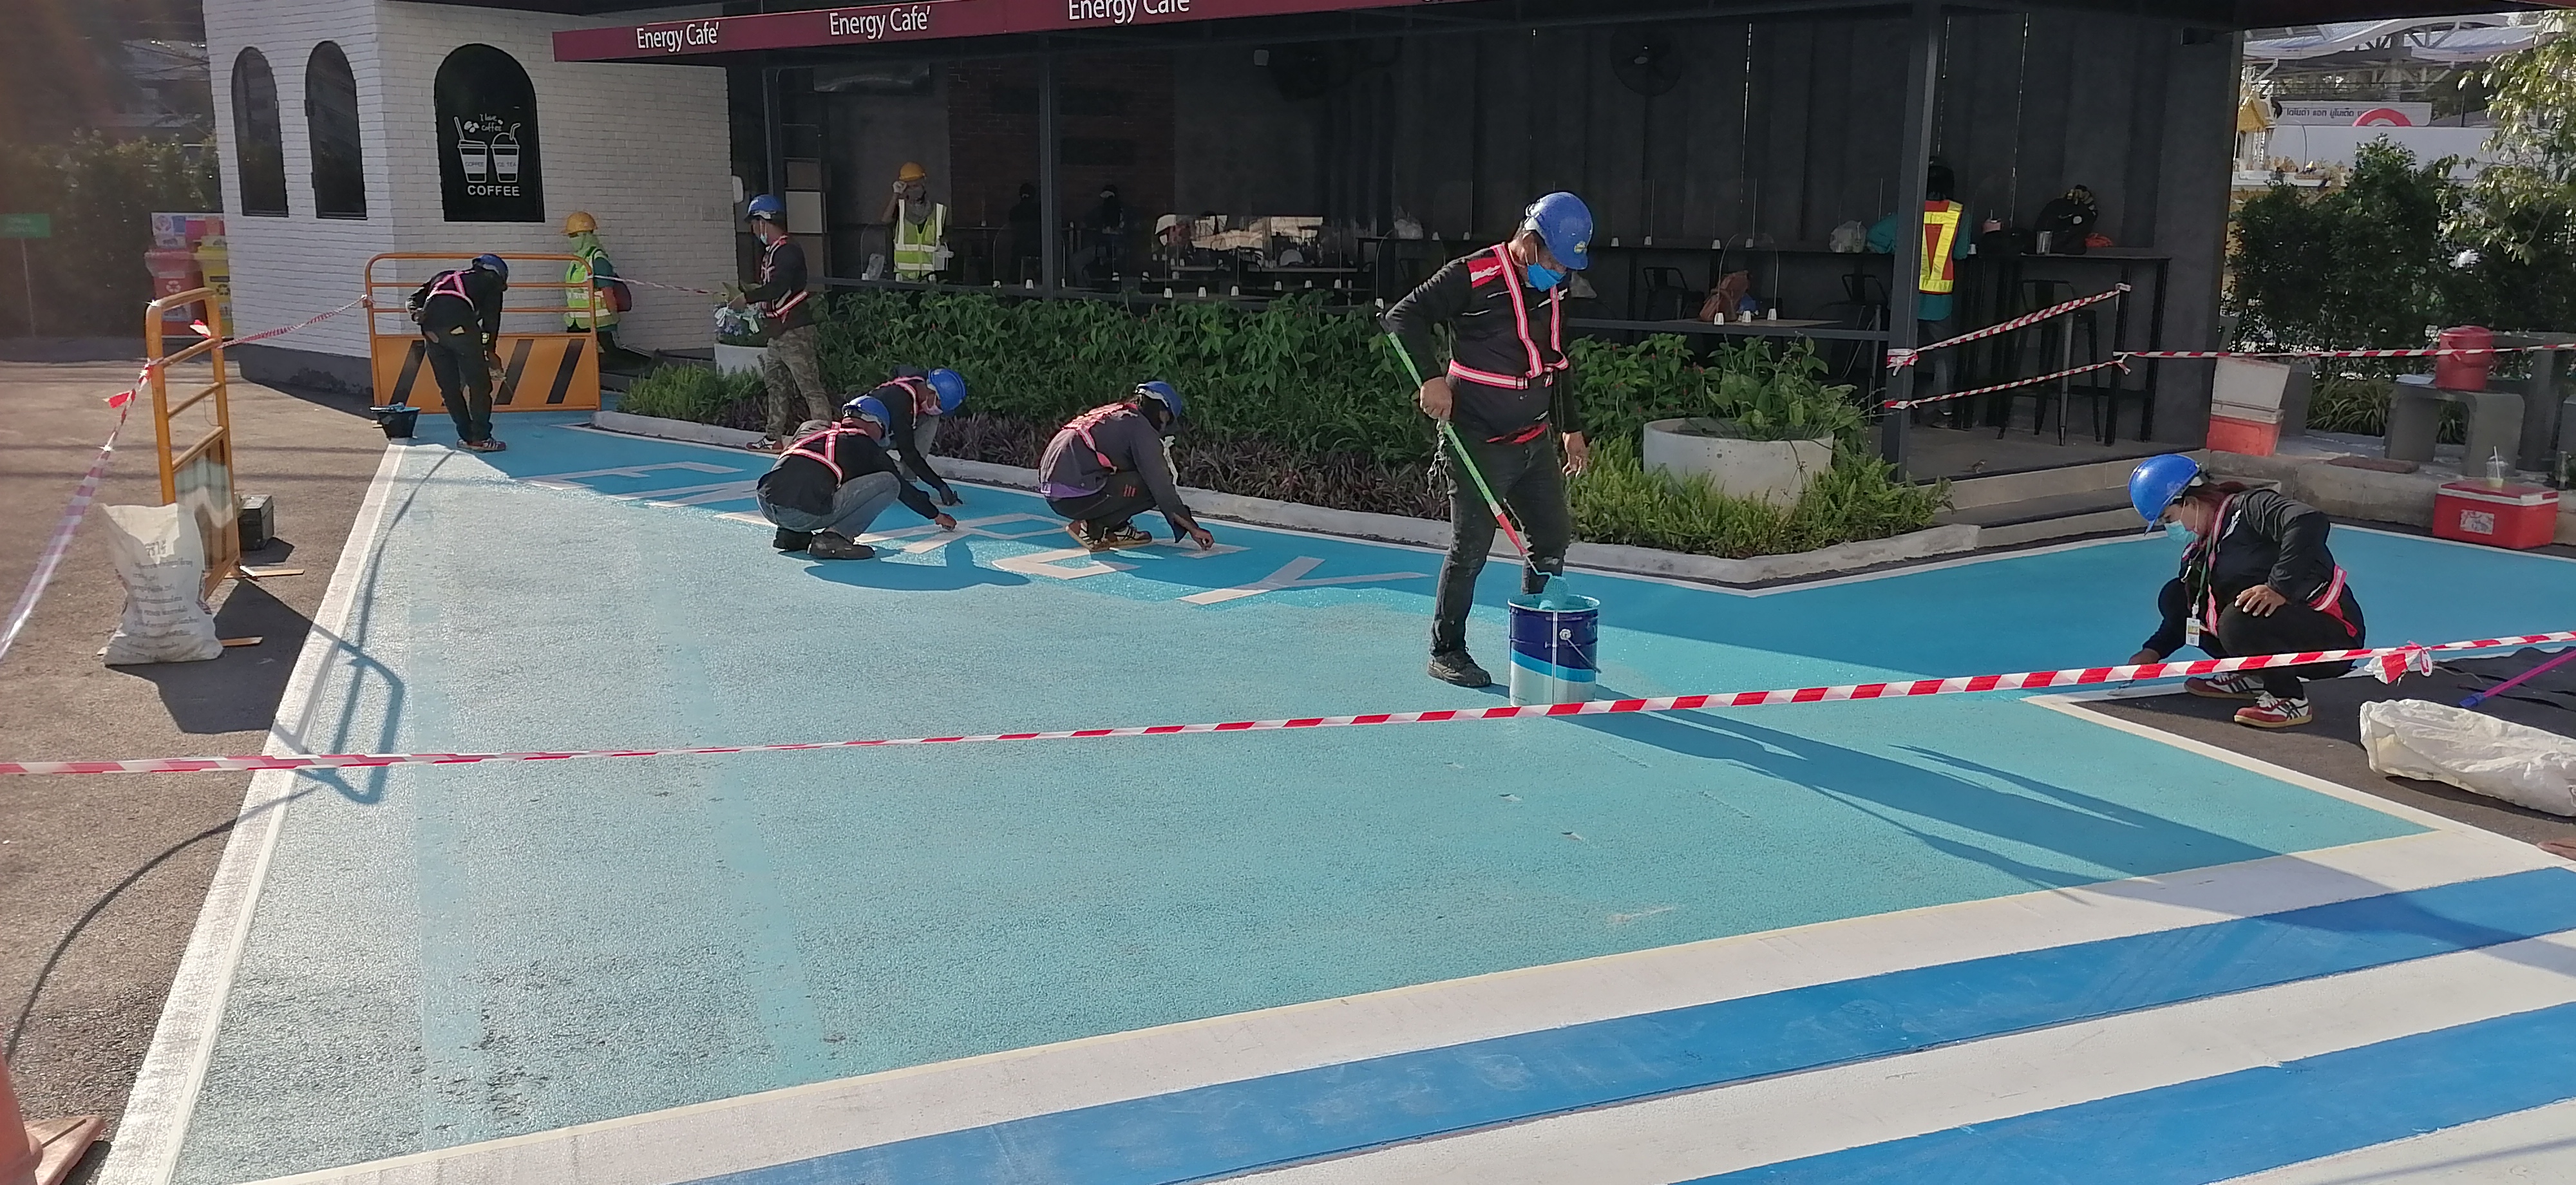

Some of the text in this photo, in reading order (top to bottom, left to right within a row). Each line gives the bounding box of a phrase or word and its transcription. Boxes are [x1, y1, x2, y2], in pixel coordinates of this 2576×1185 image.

[1069, 0, 1137, 24] Energy
[829, 12, 886, 39] Energy
[636, 28, 683, 52] Energy
[479, 113, 498, 122] I love
[467, 185, 521, 196] COFFEE
